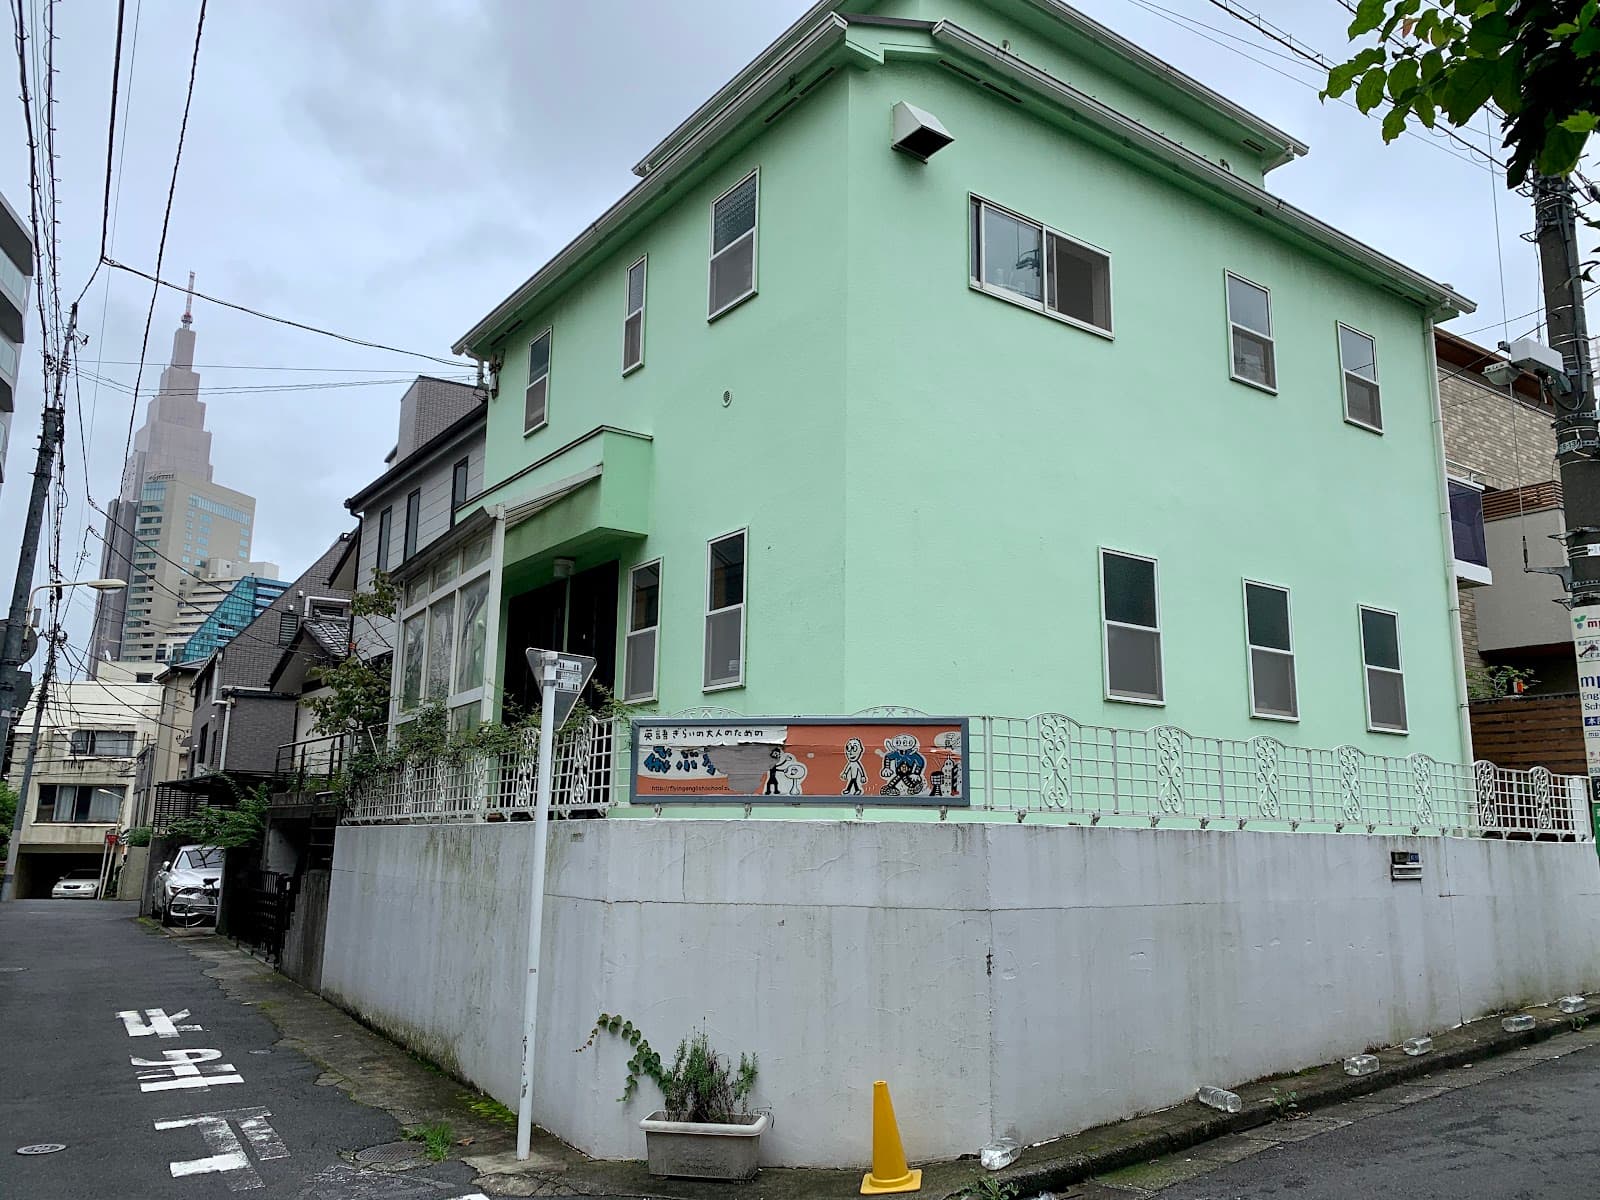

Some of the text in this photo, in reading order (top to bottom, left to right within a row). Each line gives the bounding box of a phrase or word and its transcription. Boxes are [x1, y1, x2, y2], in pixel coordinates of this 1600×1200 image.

[1587, 619, 1600, 629] m
[643, 727, 764, 741] 英語ぎらいの大人のための
